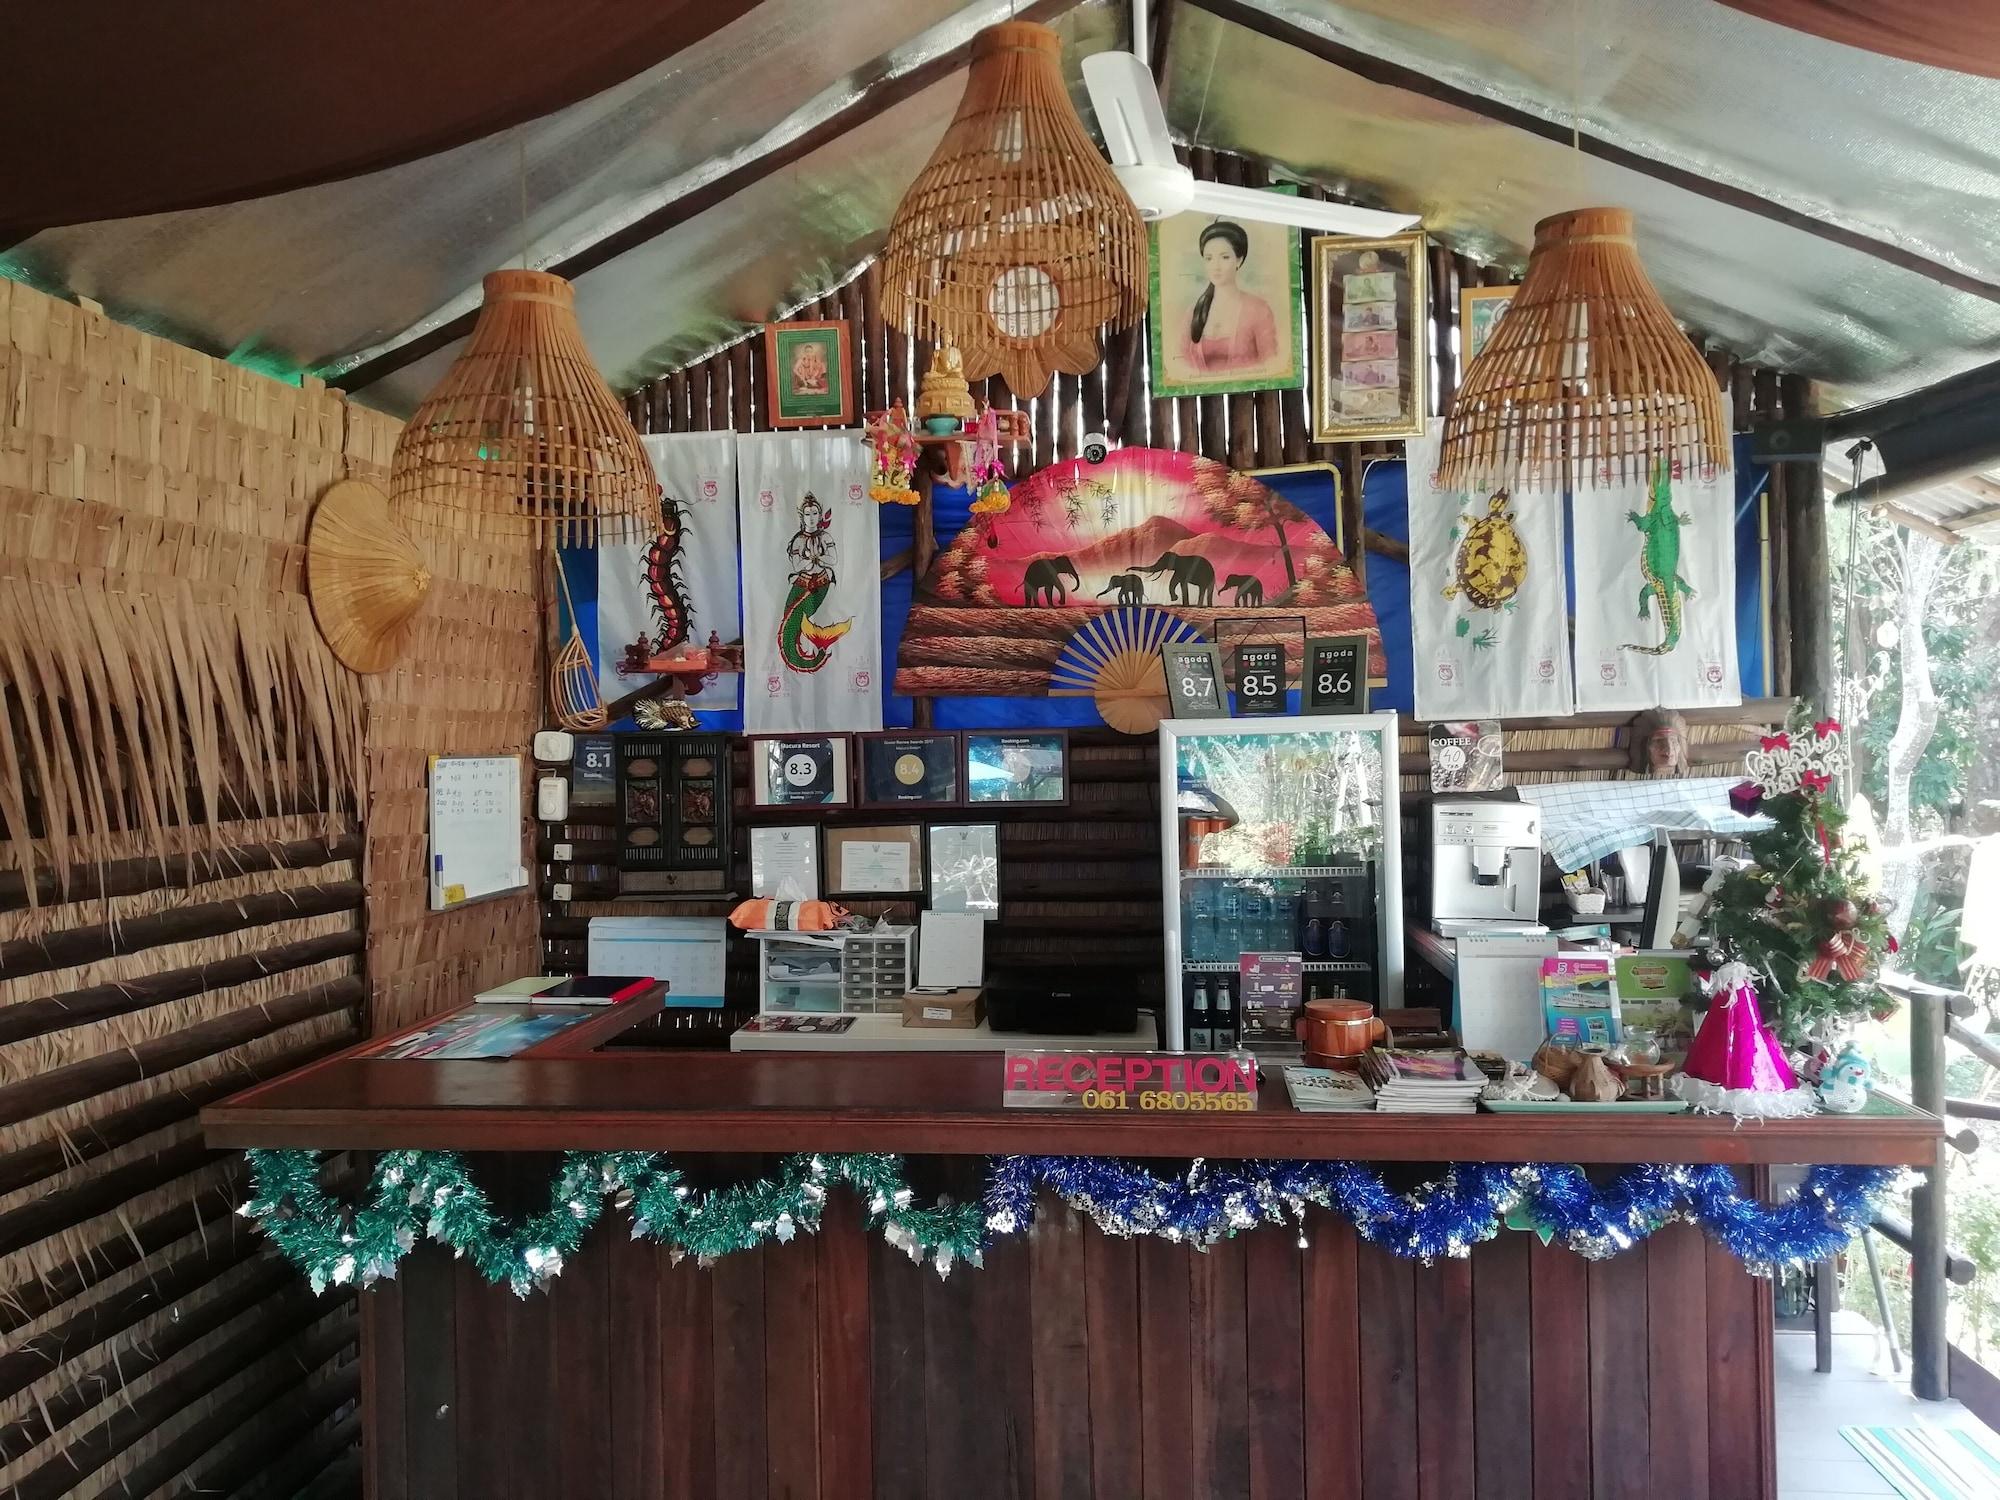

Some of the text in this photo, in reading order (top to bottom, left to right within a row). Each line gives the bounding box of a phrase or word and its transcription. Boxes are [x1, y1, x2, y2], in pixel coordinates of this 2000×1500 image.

[1178, 655, 1208, 664] agoda
[1242, 653, 1277, 662] agoda
[1319, 649, 1353, 659] agoda
[1181, 677, 1213, 697] 8.7
[1242, 674, 1278, 696] 8.5
[1317, 672, 1352, 694] 8.6
[1431, 737, 1472, 747] COFFEE
[586, 752, 611, 768] 8.1
[1443, 749, 1461, 762] 40
[790, 762, 812, 775] 8.3
[899, 763, 920, 775] 8.4
[1007, 1056, 1257, 1092] RECEPTION
[1081, 1089, 1254, 1112] 061 6805565
